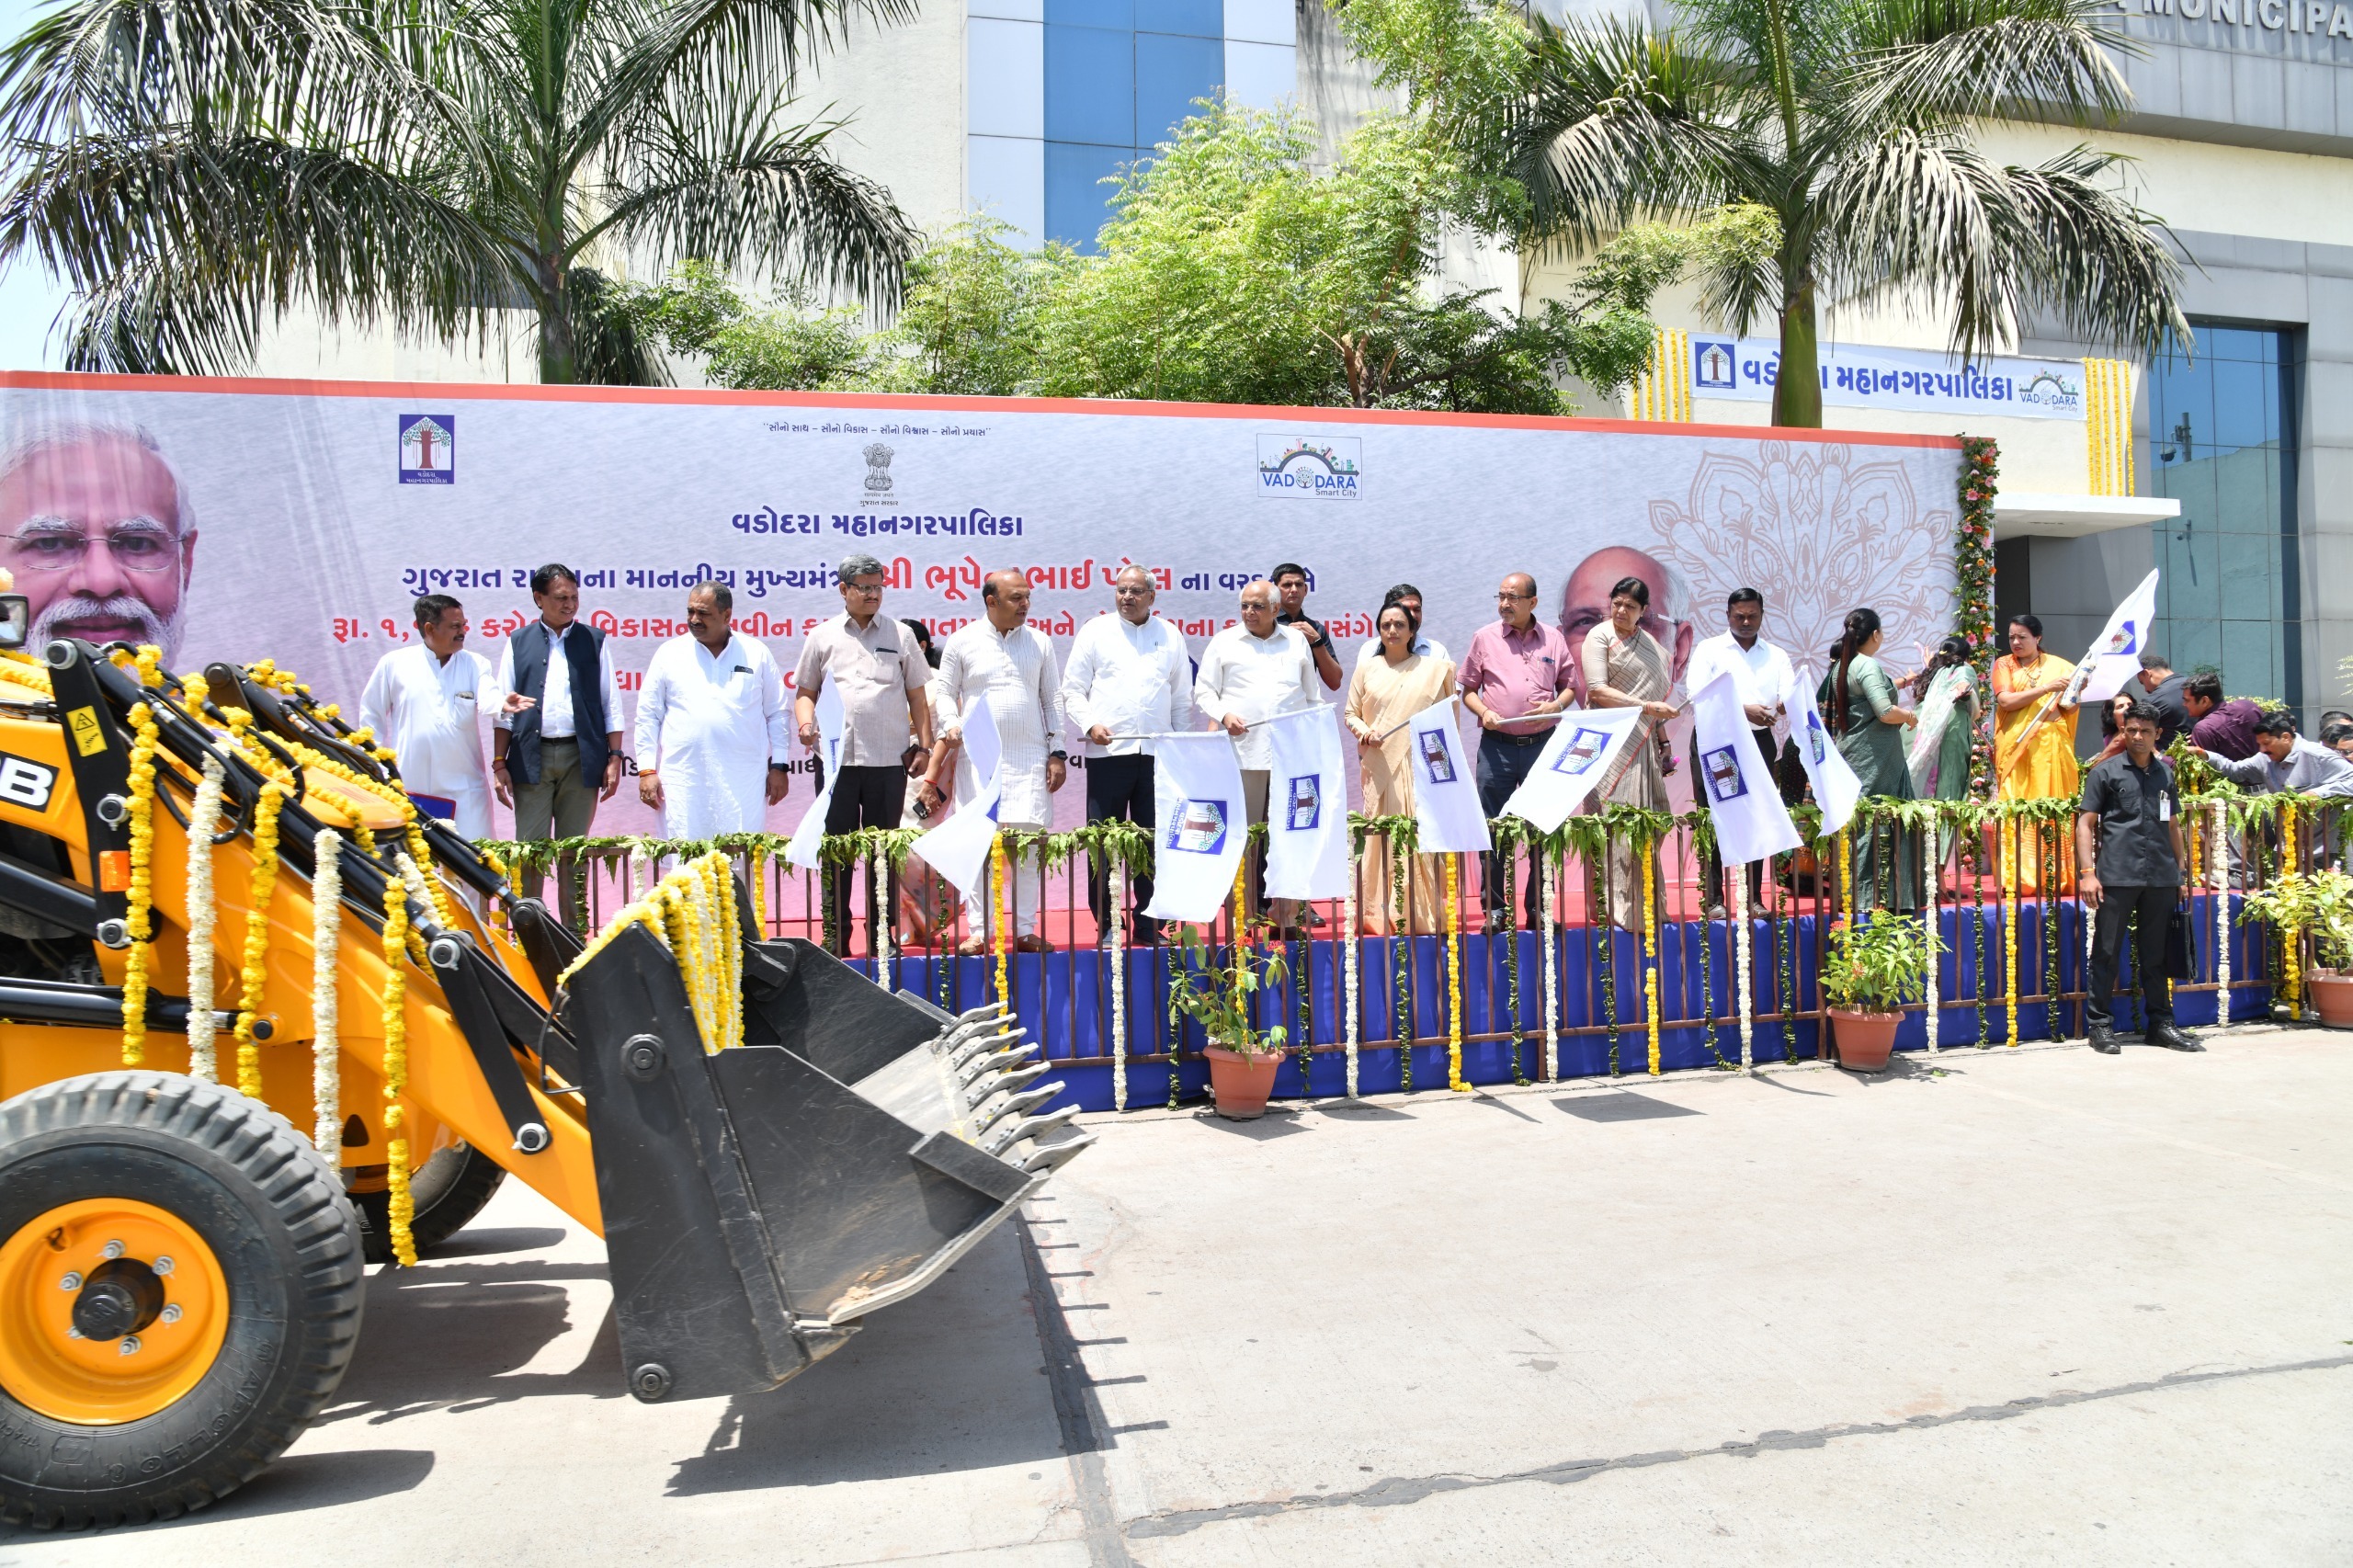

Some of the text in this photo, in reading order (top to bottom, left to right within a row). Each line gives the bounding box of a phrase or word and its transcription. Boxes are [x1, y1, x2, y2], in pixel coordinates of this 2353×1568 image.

[1836, 365, 2013, 401] મહાનગરપાલિકા
[1315, 488, 1358, 498] Smart City
[732, 506, 1023, 538] વડોદરા મહાનગરપાલિકા
[402, 568, 502, 597] ગુજરાત
[626, 562, 735, 589] માનનીય
[1181, 573, 1210, 591] ના
